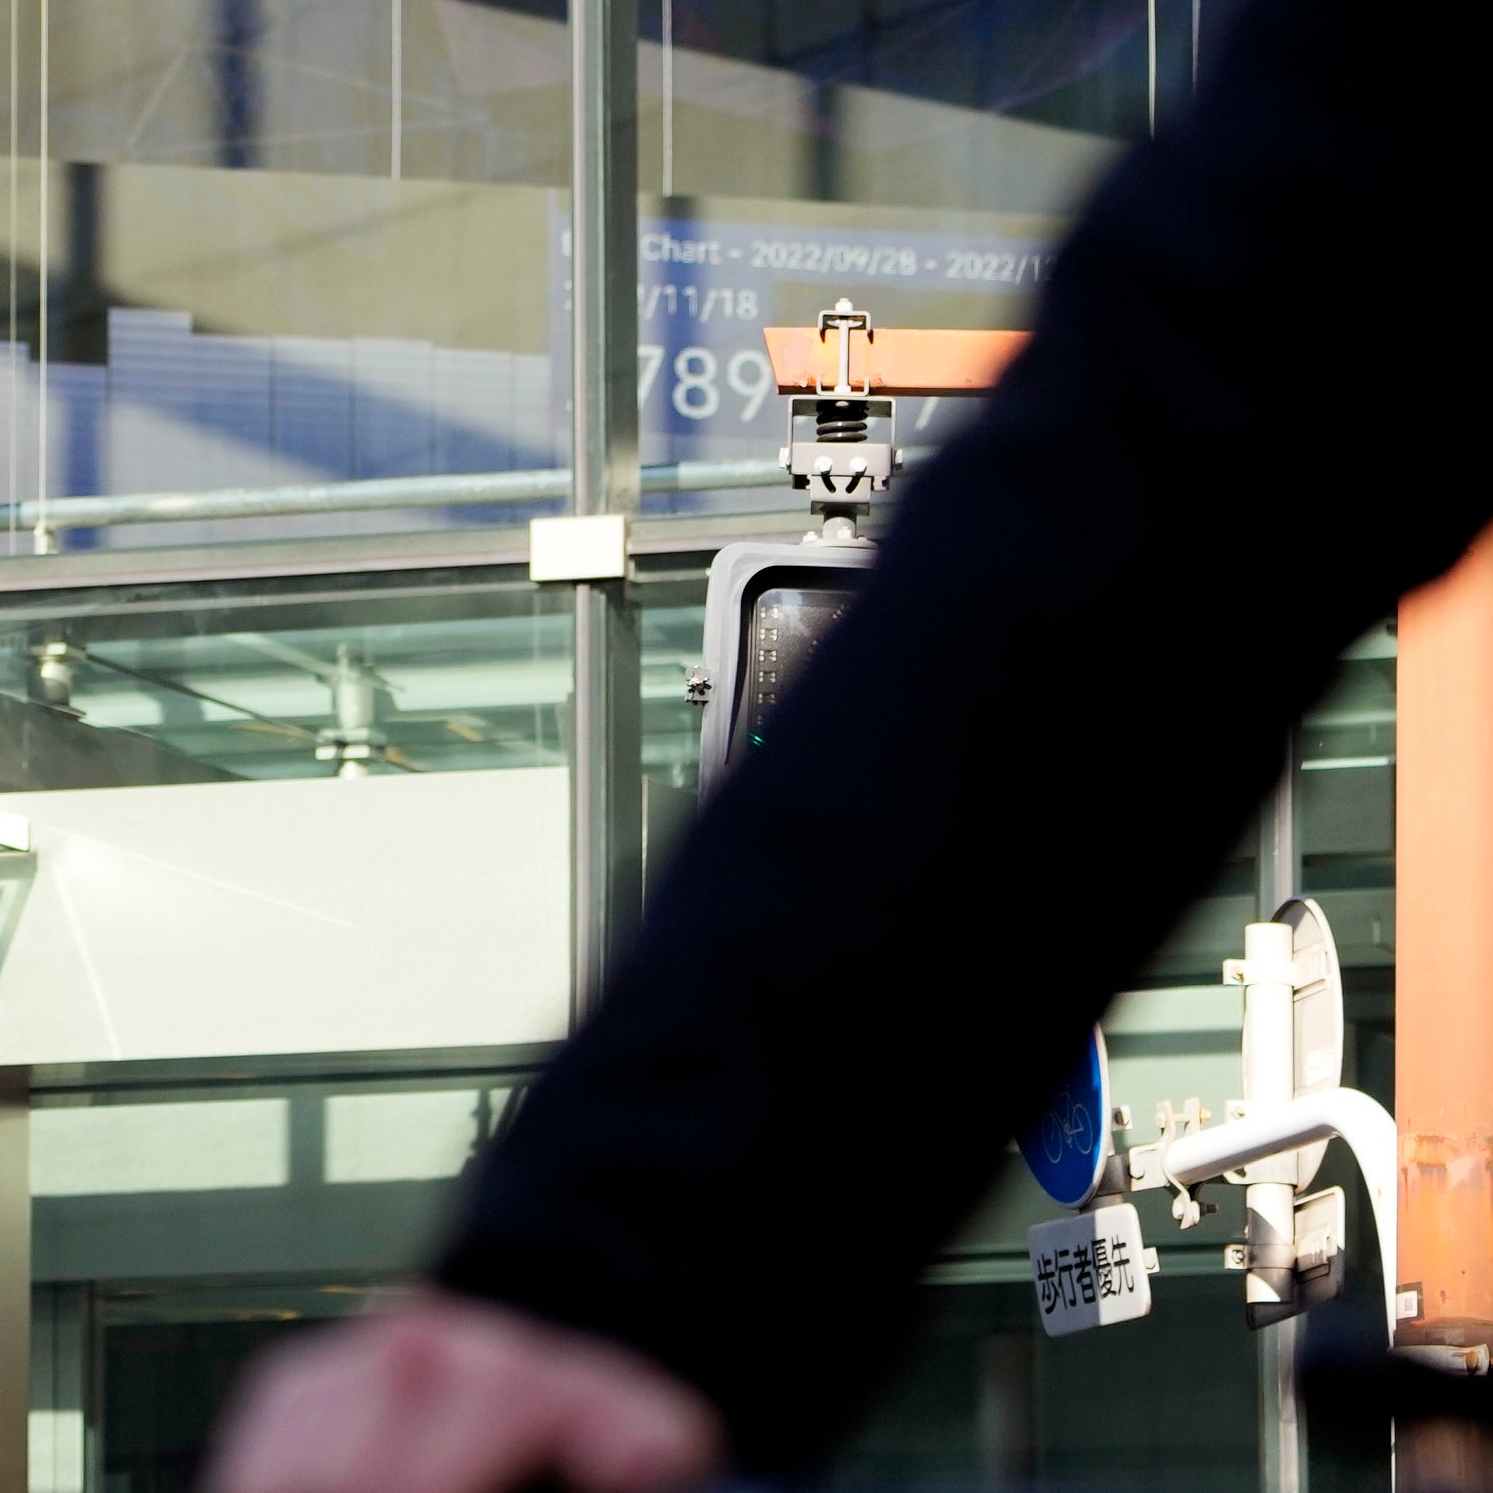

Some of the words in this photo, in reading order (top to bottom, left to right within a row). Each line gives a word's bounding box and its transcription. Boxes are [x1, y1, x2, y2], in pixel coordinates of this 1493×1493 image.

[640, 233, 722, 265] Chart
[1037, 1235, 1135, 1315] 歩行者優先
